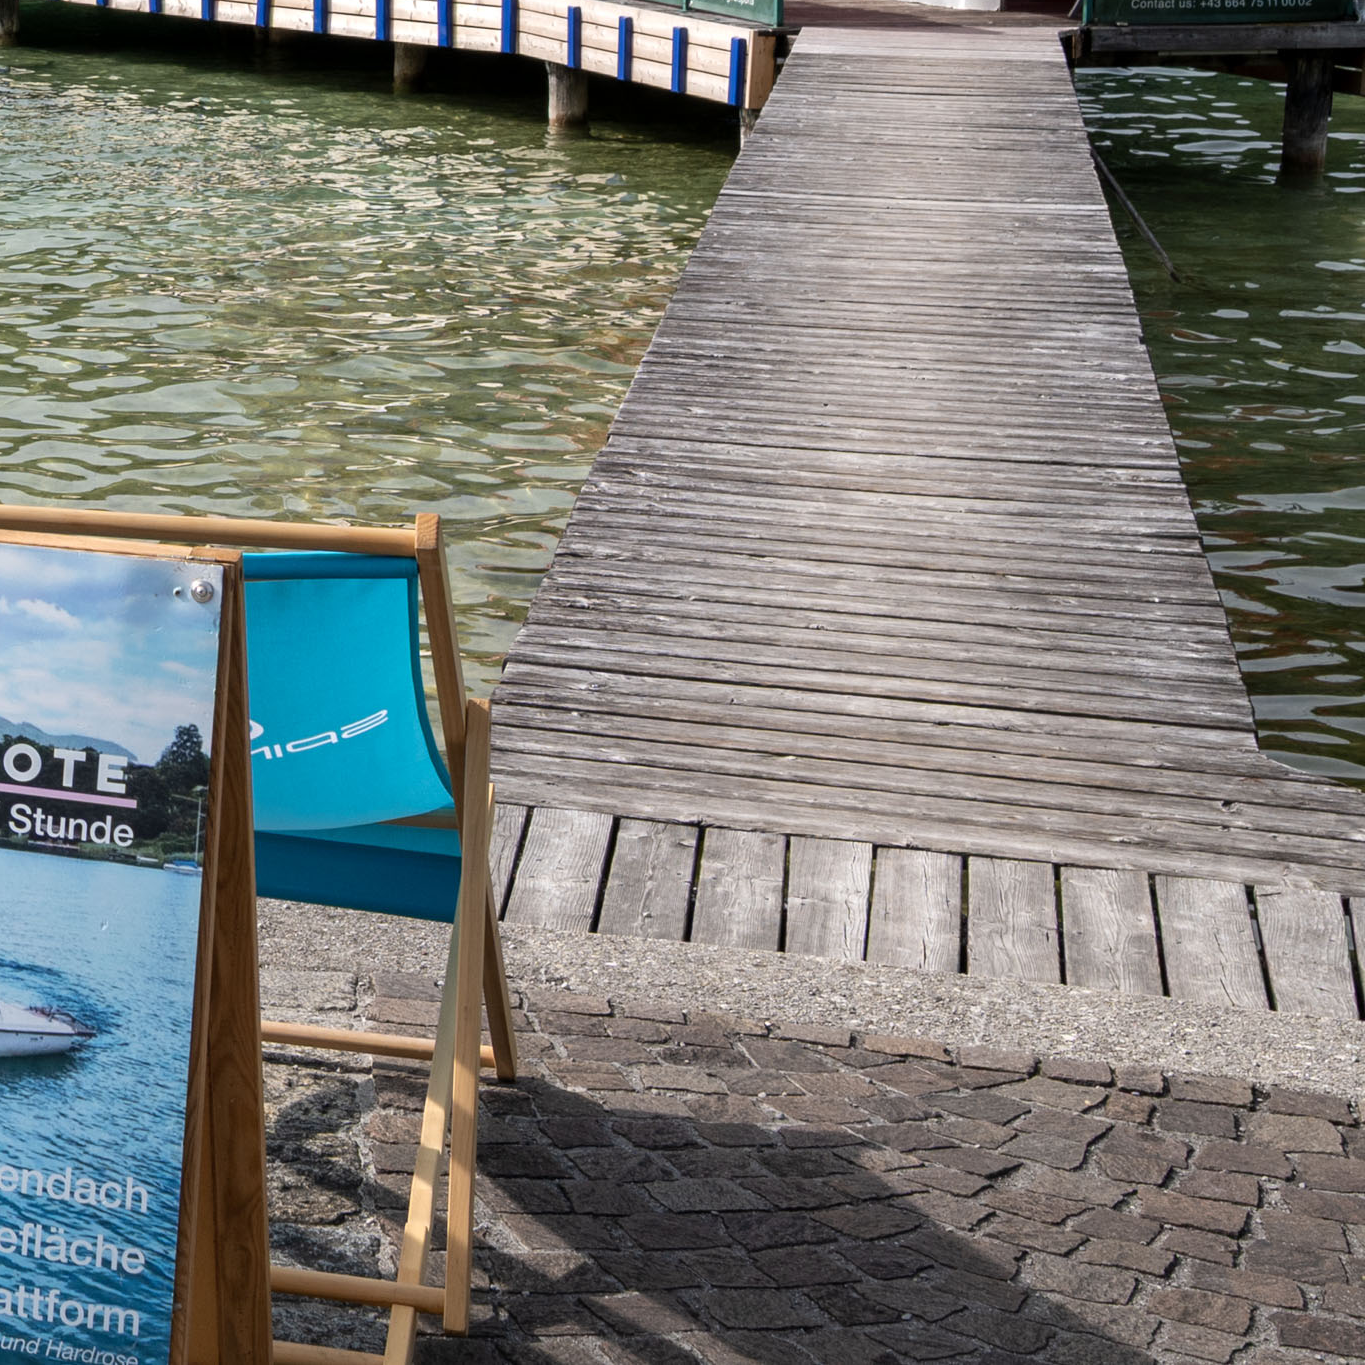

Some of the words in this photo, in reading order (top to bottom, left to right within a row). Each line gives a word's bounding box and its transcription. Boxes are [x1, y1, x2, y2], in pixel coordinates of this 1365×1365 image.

[8, 803, 134, 847] Stunde
[0, 1334, 39, 1355] und
[45, 1340, 140, 1365] Hardrose
